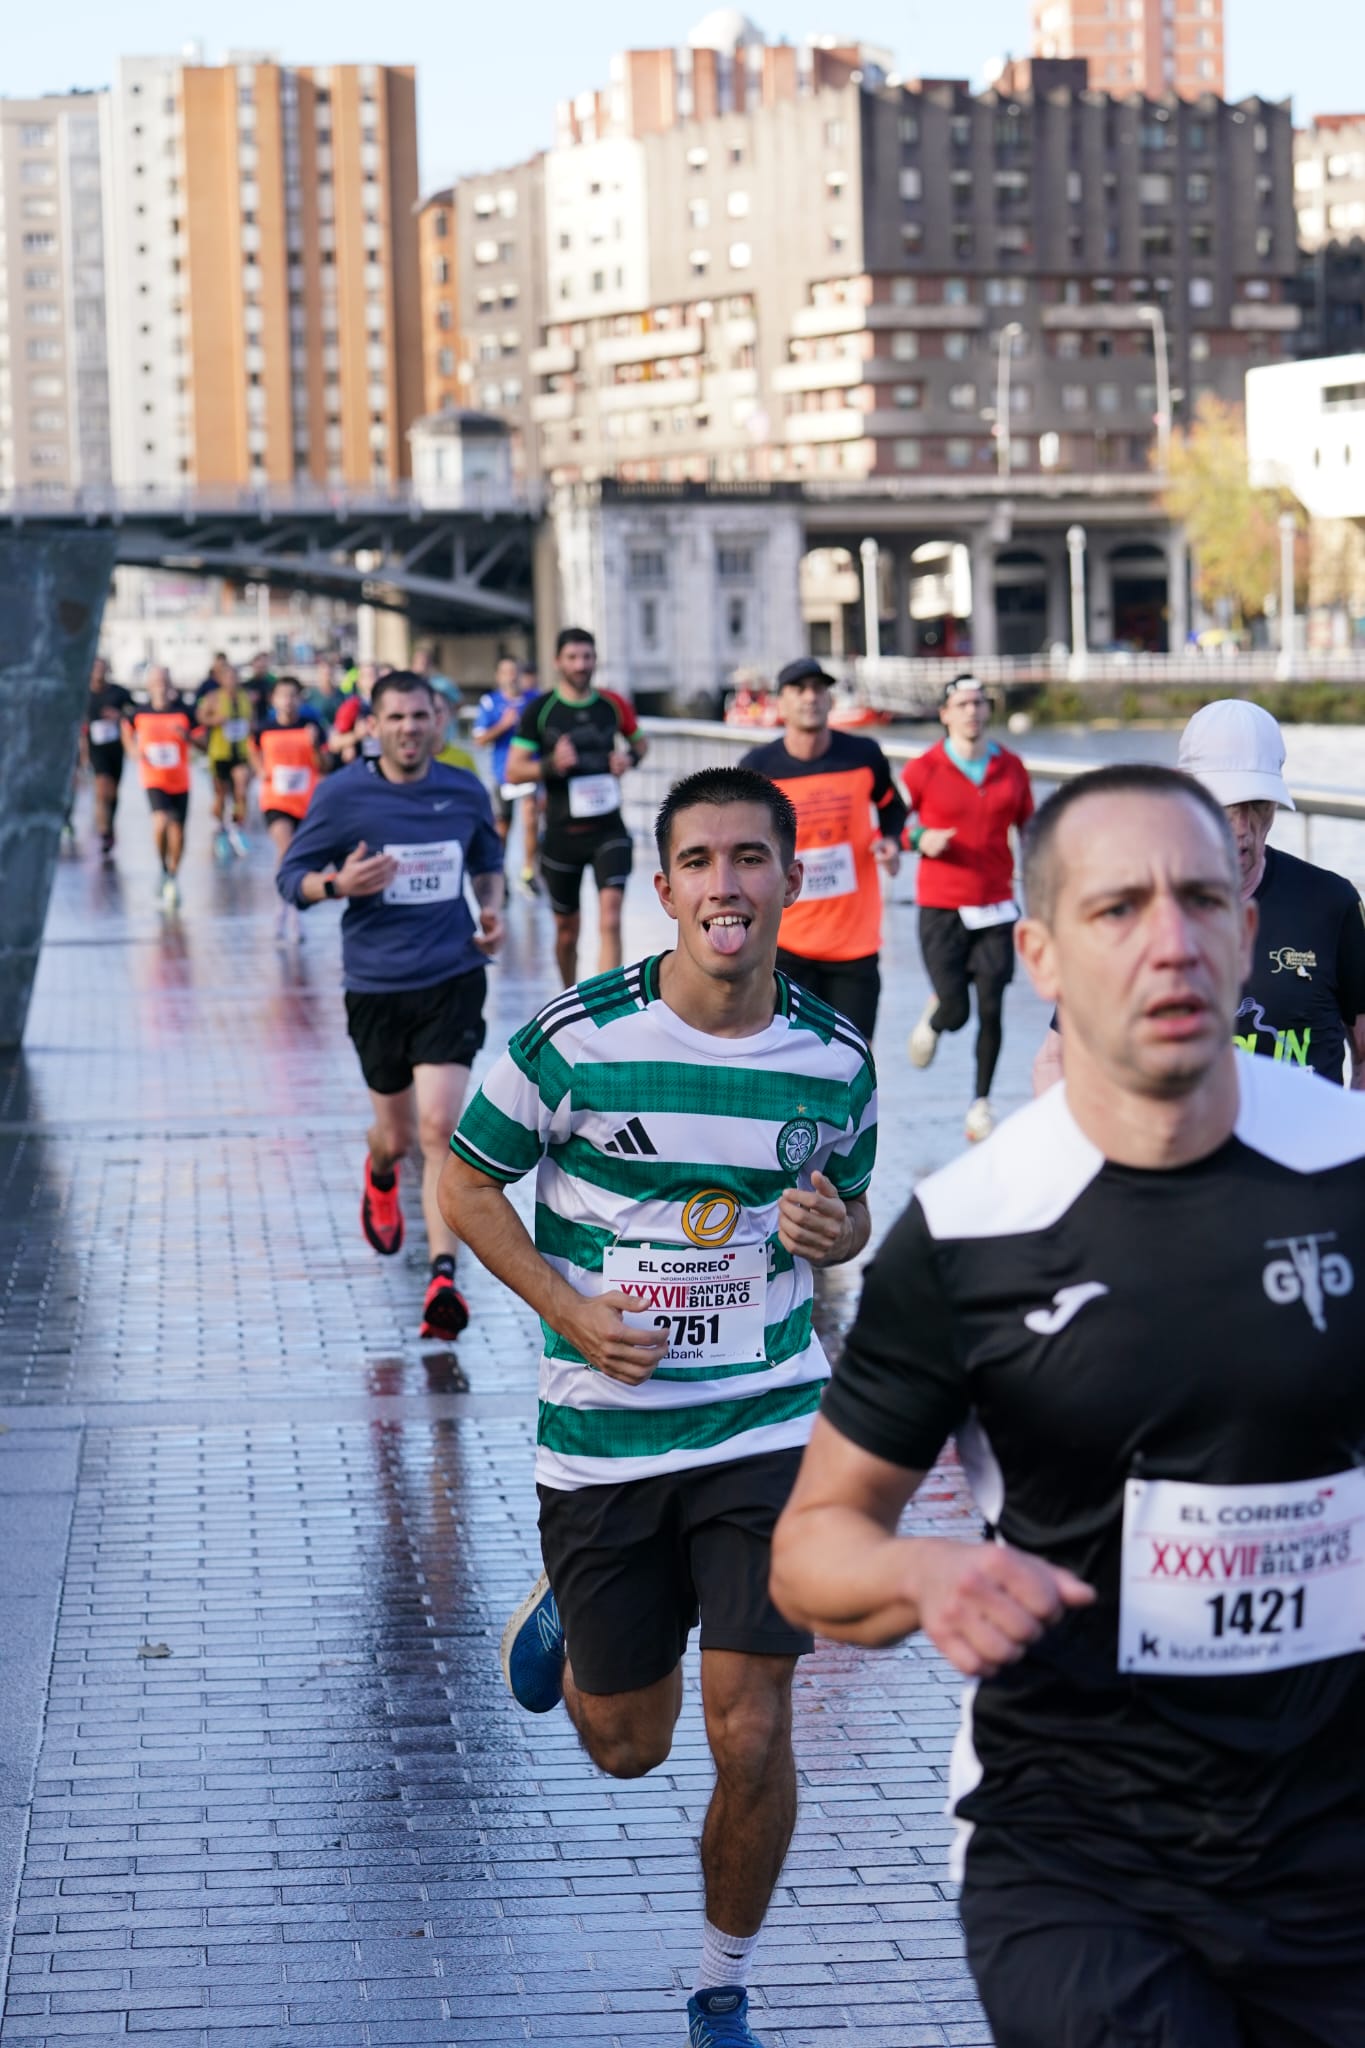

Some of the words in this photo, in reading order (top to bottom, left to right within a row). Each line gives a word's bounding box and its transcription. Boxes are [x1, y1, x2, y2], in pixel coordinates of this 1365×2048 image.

[638, 1261, 659, 1273] EL
[661, 1260, 730, 1274] CORREO
[689, 1292, 750, 1308] BILBAO
[690, 1281, 751, 1296] SANTURCE
[653, 1314, 720, 1346] 2751
[1179, 1504, 1211, 1524] EL
[1218, 1498, 1326, 1525] CORREO
[1150, 1541, 1258, 1579] XXXVII
[1262, 1528, 1351, 1556] SANTURCE
[1261, 1543, 1351, 1576] BILBAO
[1205, 1585, 1307, 1639] 1421
